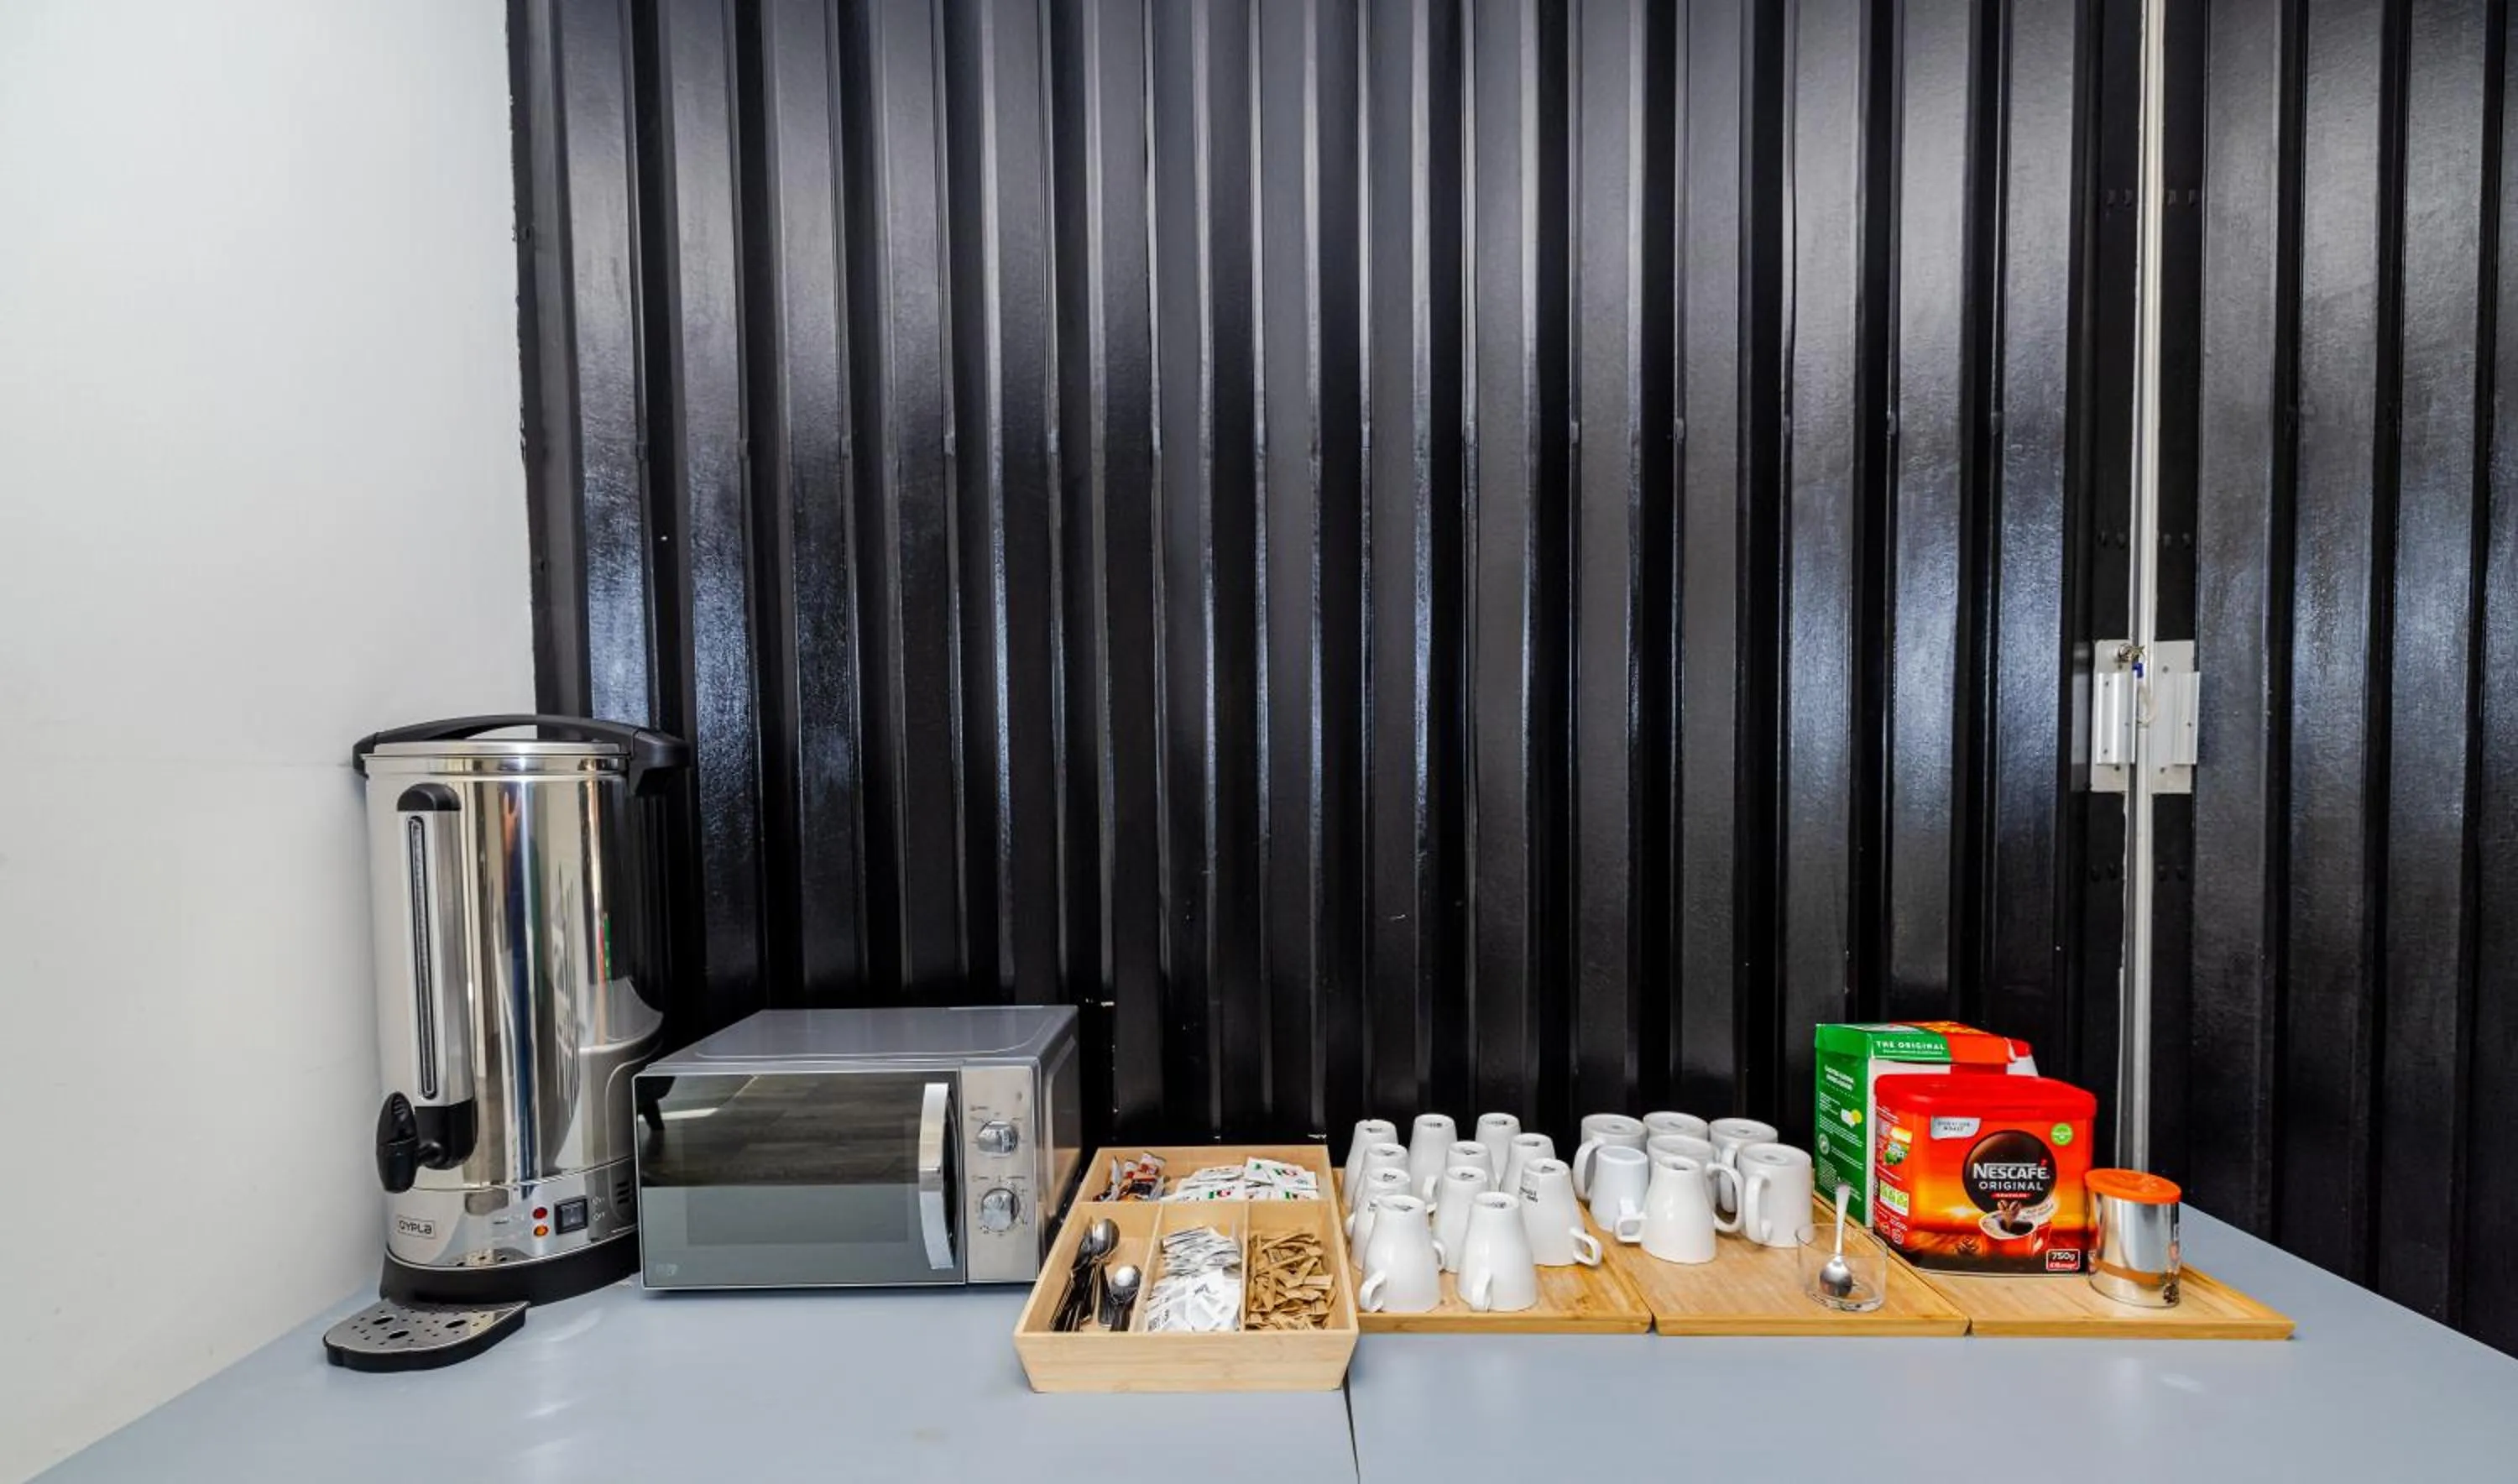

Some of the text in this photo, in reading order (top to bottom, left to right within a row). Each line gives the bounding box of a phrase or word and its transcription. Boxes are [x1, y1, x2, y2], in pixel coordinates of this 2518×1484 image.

[1898, 1042, 1945, 1050] ORIGINAL
[1973, 1159, 2050, 1179] NESCAFÉ
[1979, 1181, 2044, 1191] ORIGINAL
[2051, 1251, 2075, 1262] 750g
